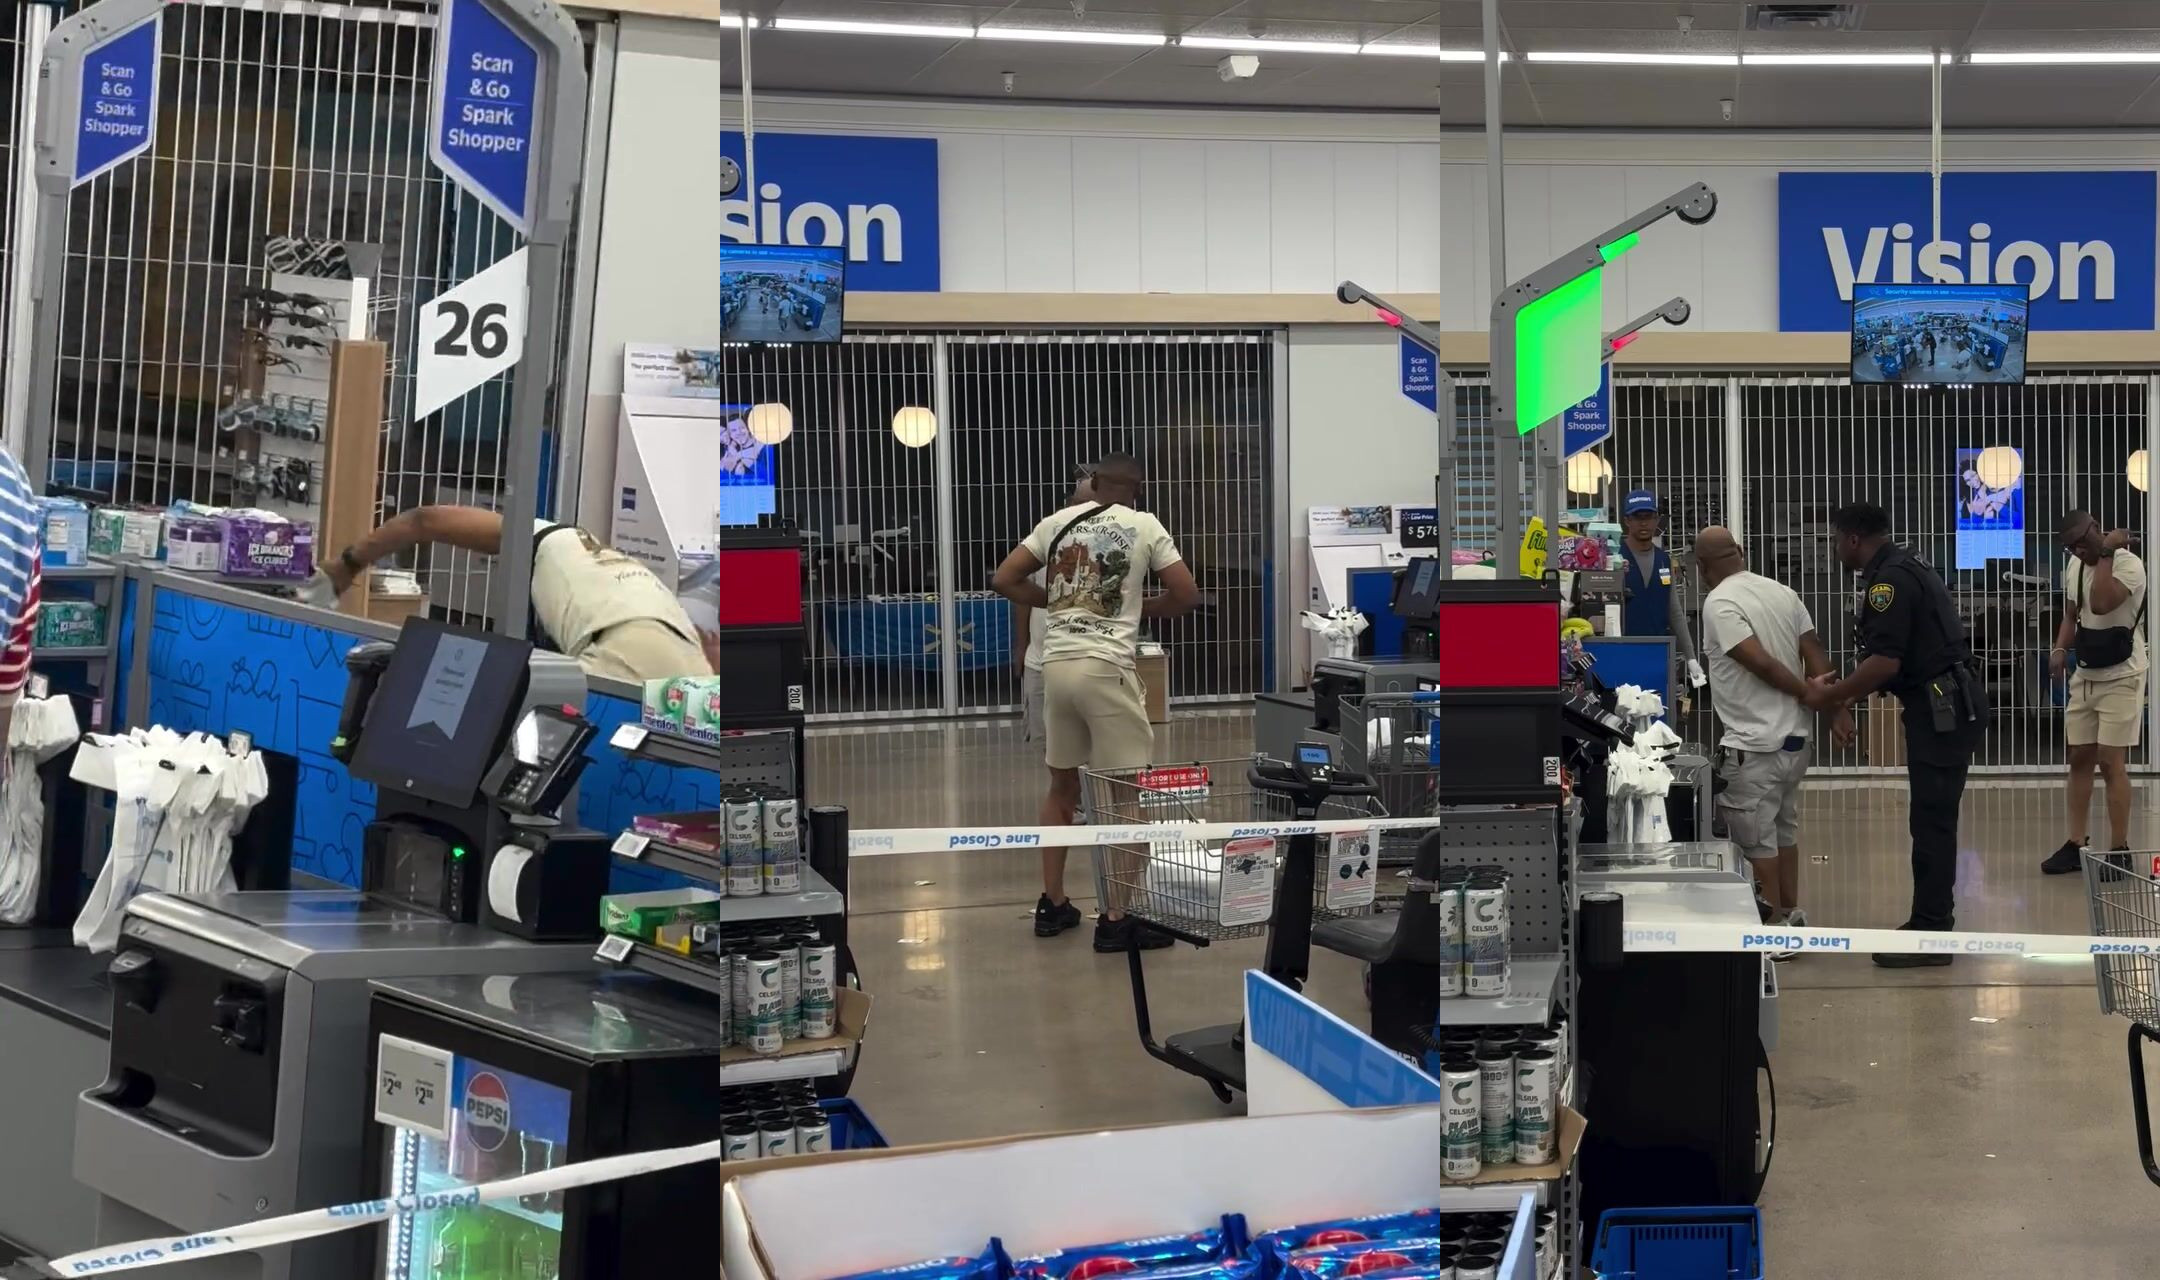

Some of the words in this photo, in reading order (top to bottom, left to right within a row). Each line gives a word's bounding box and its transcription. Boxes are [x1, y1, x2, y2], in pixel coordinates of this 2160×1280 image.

[101, 63, 135, 79] Scan
[471, 52, 513, 74] Scan
[101, 81, 110, 95] &
[113, 83, 132, 97] Go
[470, 78, 483, 96] &
[486, 80, 510, 99] Go
[95, 101, 136, 116] Spark
[462, 104, 514, 126] Spark
[85, 118, 144, 136] Shopper
[448, 128, 525, 152] Shopper
[1822, 223, 2116, 300] Vision
[434, 300, 508, 358] 26
[1584, 400, 1597, 408] Go
[1573, 411, 1600, 420] Spark
[1567, 422, 1607, 431] Shopper
[643, 716, 678, 732] mentos
[684, 725, 720, 742] mentos
[1545, 760, 1557, 777] 200
[1232, 827, 1280, 837] Closed
[1284, 826, 1317, 834] Lane
[949, 834, 1001, 849] Closed
[1006, 834, 1041, 846] Lane
[1743, 935, 1803, 949] Closed
[1808, 937, 1851, 950] Lane
[2089, 943, 2150, 953] Closed
[466, 1097, 508, 1126] PEPSI
[1449, 1107, 1476, 1115] CELSIUS
[396, 1187, 480, 1212] Closed
